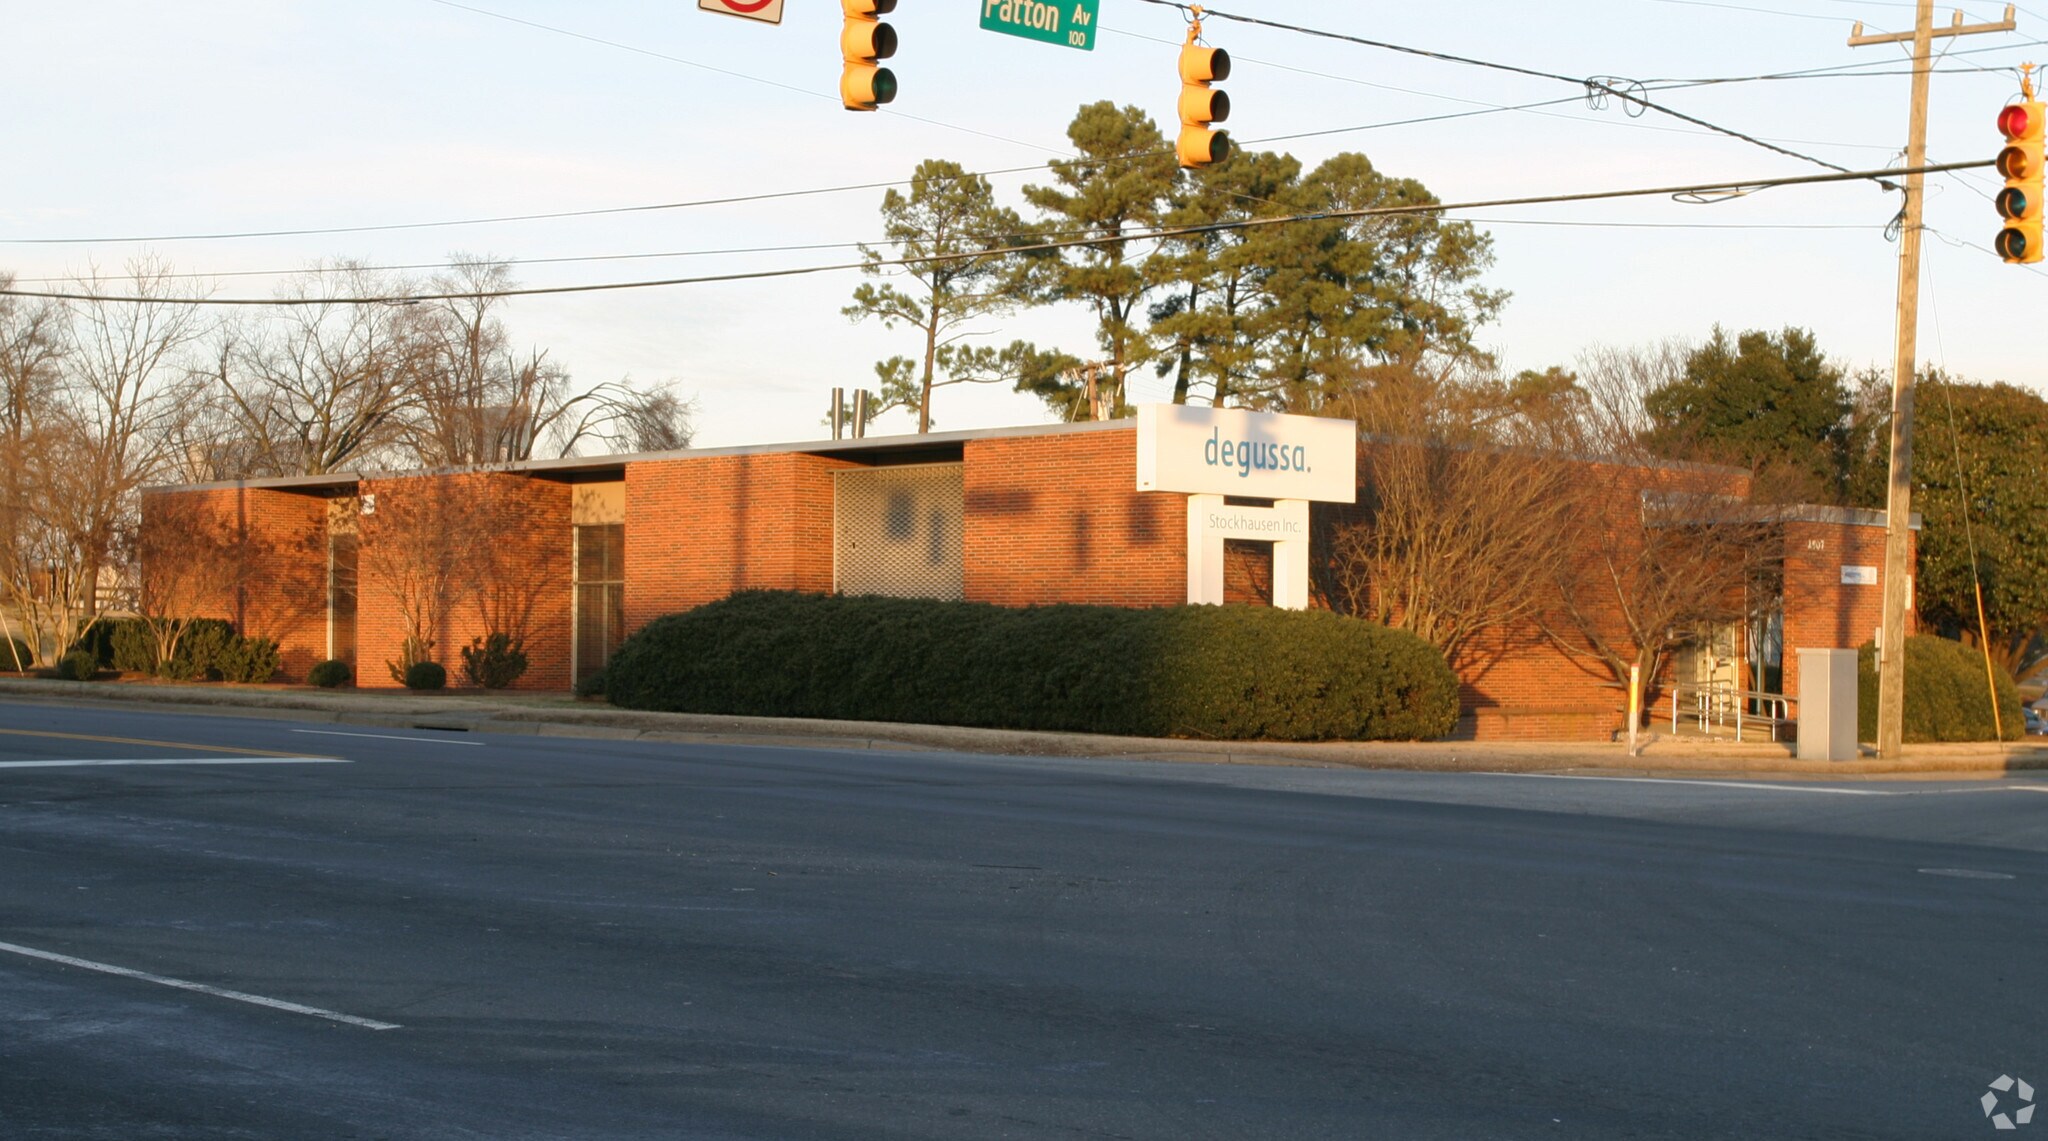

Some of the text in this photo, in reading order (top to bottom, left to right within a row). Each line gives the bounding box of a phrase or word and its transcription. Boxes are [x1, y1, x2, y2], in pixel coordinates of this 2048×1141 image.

[1072, 4, 1091, 26] Av
[1068, 30, 1086, 47] 100
[1204, 426, 1312, 478] degussa.
[1209, 513, 1302, 533] Stockhausen Inc.
